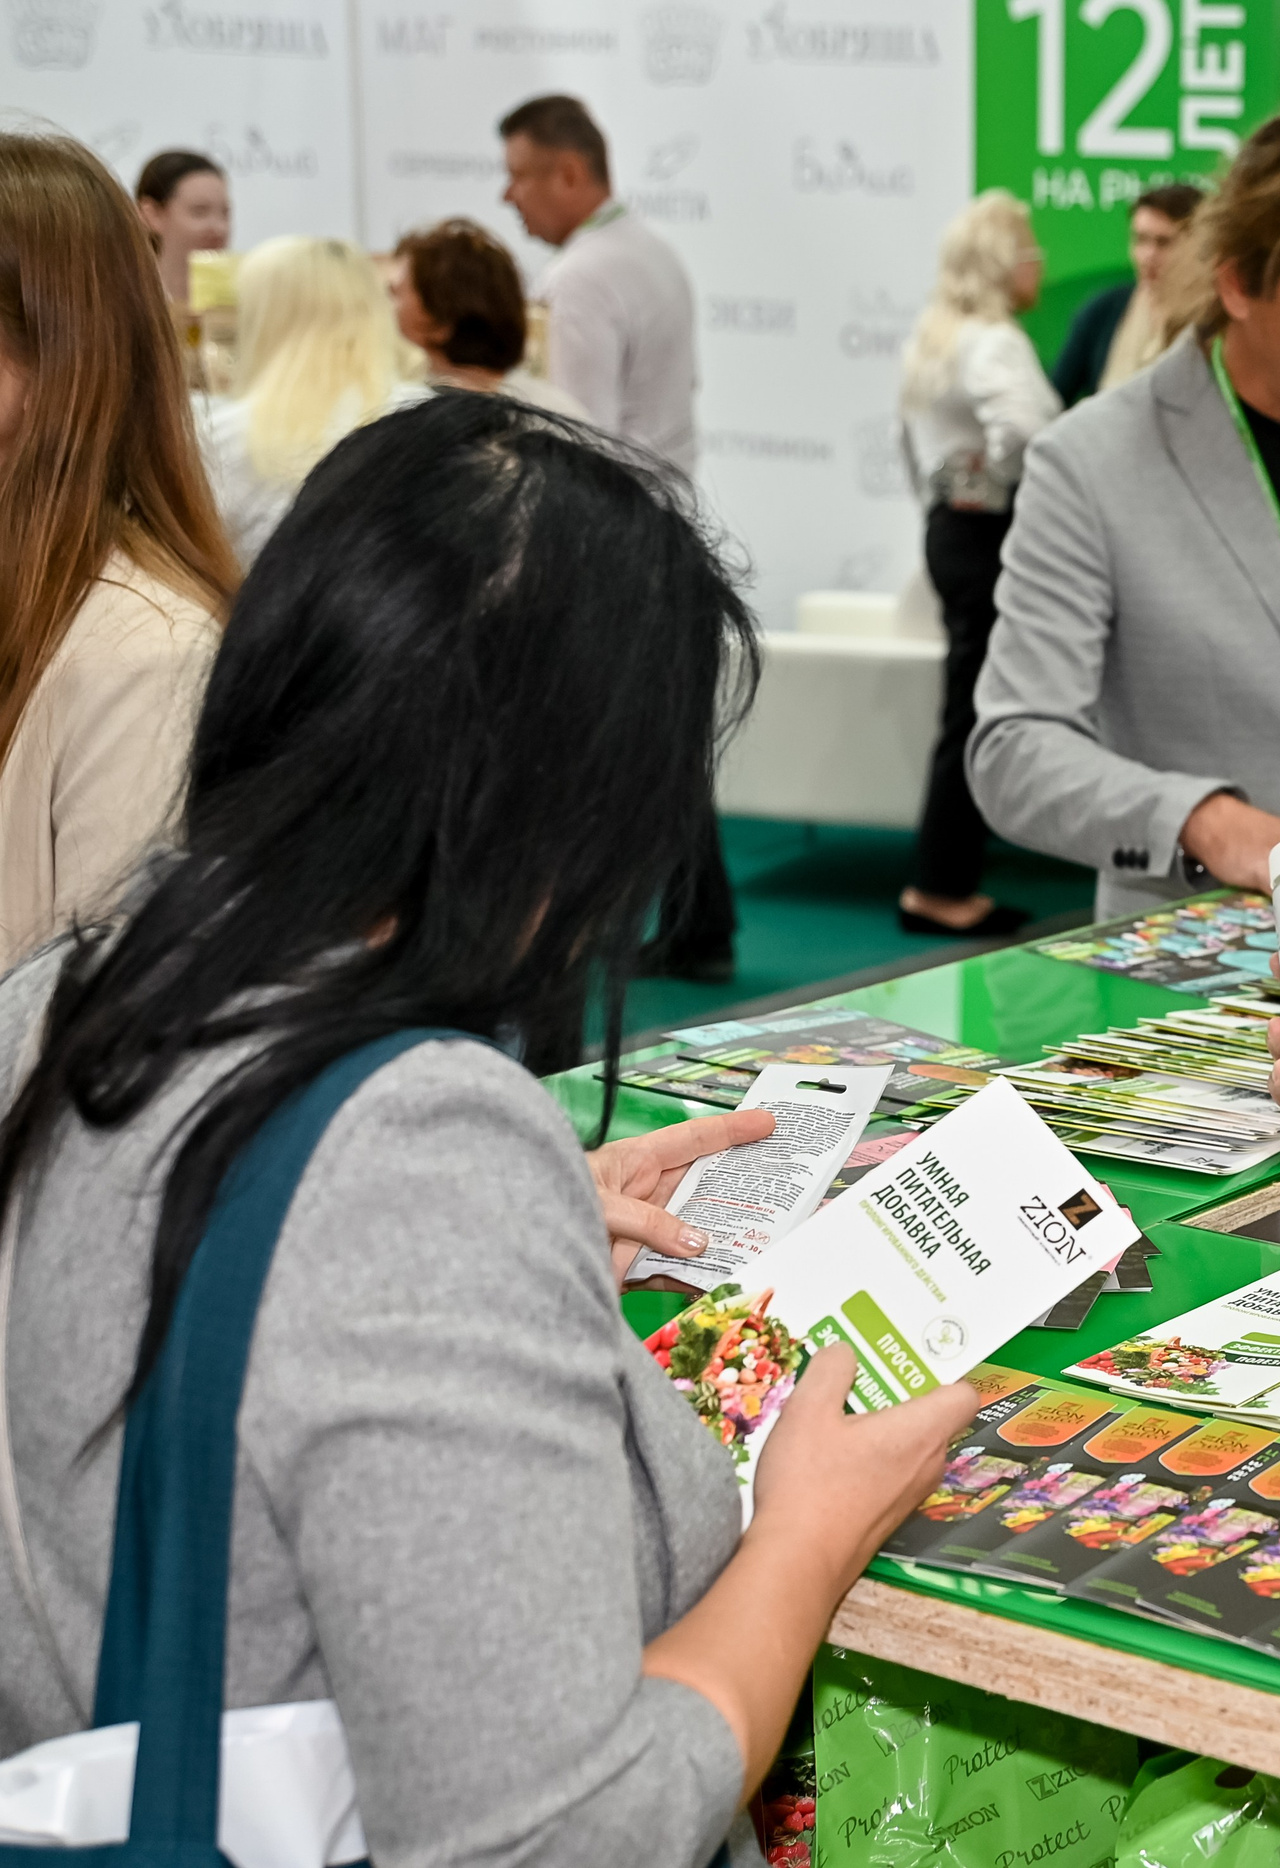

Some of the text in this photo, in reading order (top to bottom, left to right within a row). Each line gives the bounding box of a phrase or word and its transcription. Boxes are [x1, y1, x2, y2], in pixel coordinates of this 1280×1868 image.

[1008, 0, 1174, 160] 12
[1180, 0, 1246, 162] ЛЕТ
[1032, 167, 1094, 210] НА
[916, 1151, 970, 1209] УМНАЯ
[732, 1240, 745, 1250] Вес
[749, 1244, 759, 1253] 30
[870, 1184, 942, 1259] ДОБАВКА
[896, 1168, 992, 1276] ПИТАТЕЛЬНАЯ
[1020, 1195, 1087, 1265] ZION
[876, 1333, 927, 1389] ПРОСТО
[1038, 1405, 1086, 1419] ZION
[1123, 1421, 1172, 1435] ZION
[943, 1726, 1023, 1785] Protect
[953, 1802, 1001, 1838] ZION
[995, 1819, 1092, 1868] Protect
